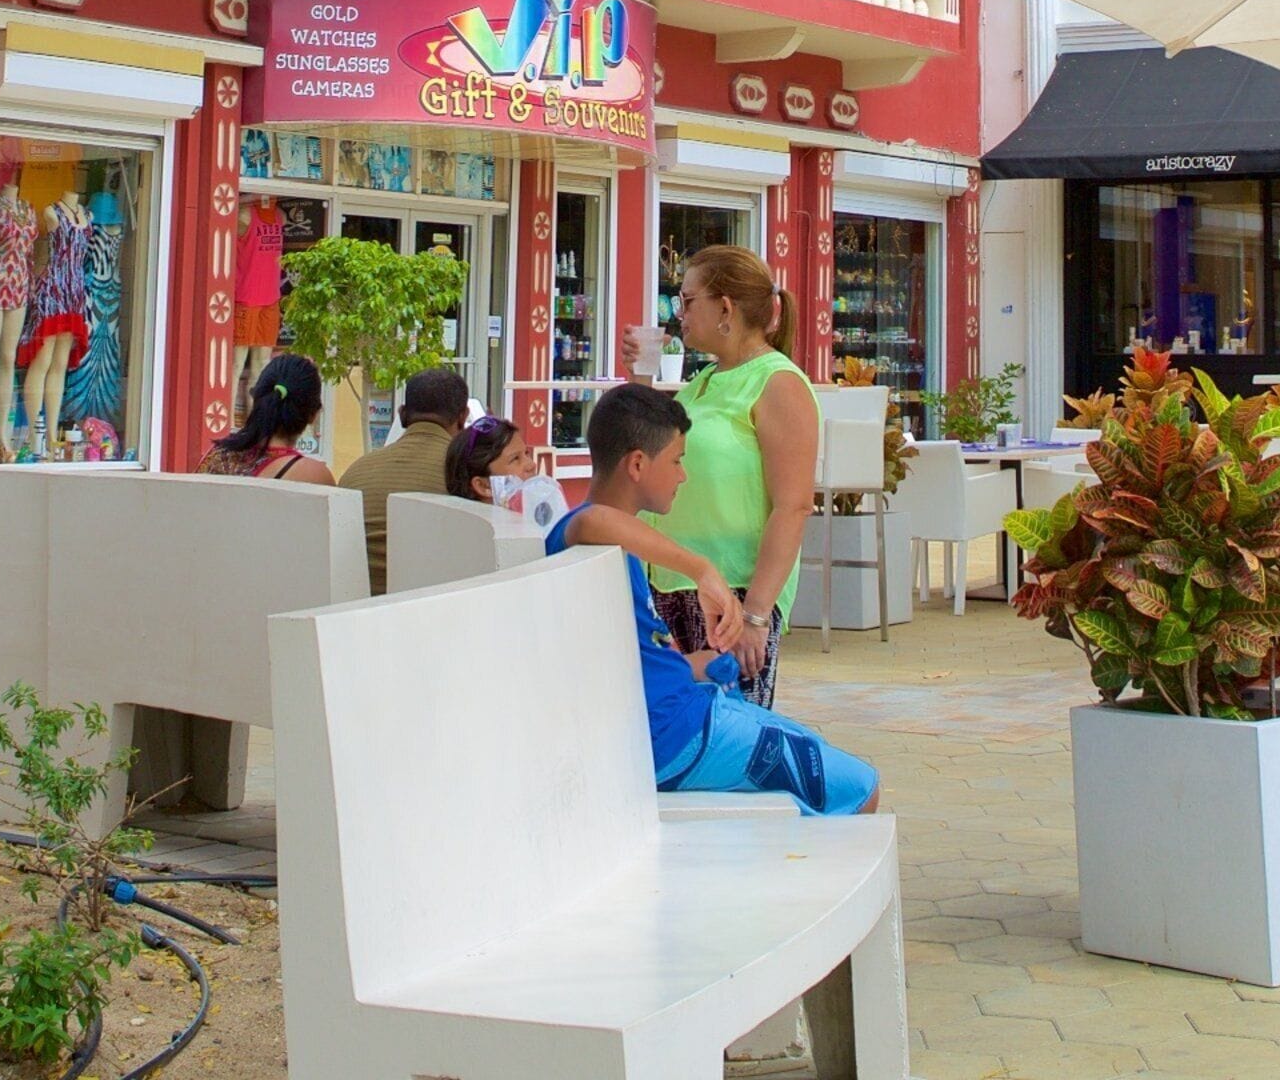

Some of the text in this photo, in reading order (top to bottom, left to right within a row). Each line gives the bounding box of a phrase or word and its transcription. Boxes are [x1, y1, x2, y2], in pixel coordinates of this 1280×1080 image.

[310, 4, 359, 23] GOLD
[290, 28, 377, 49] WATCHES
[275, 53, 390, 75] SUNGLASSES
[291, 79, 375, 98] CAMERAS
[420, 71, 648, 140] Gift & Souvenirs
[1145, 154, 1237, 172] aristocrazy
